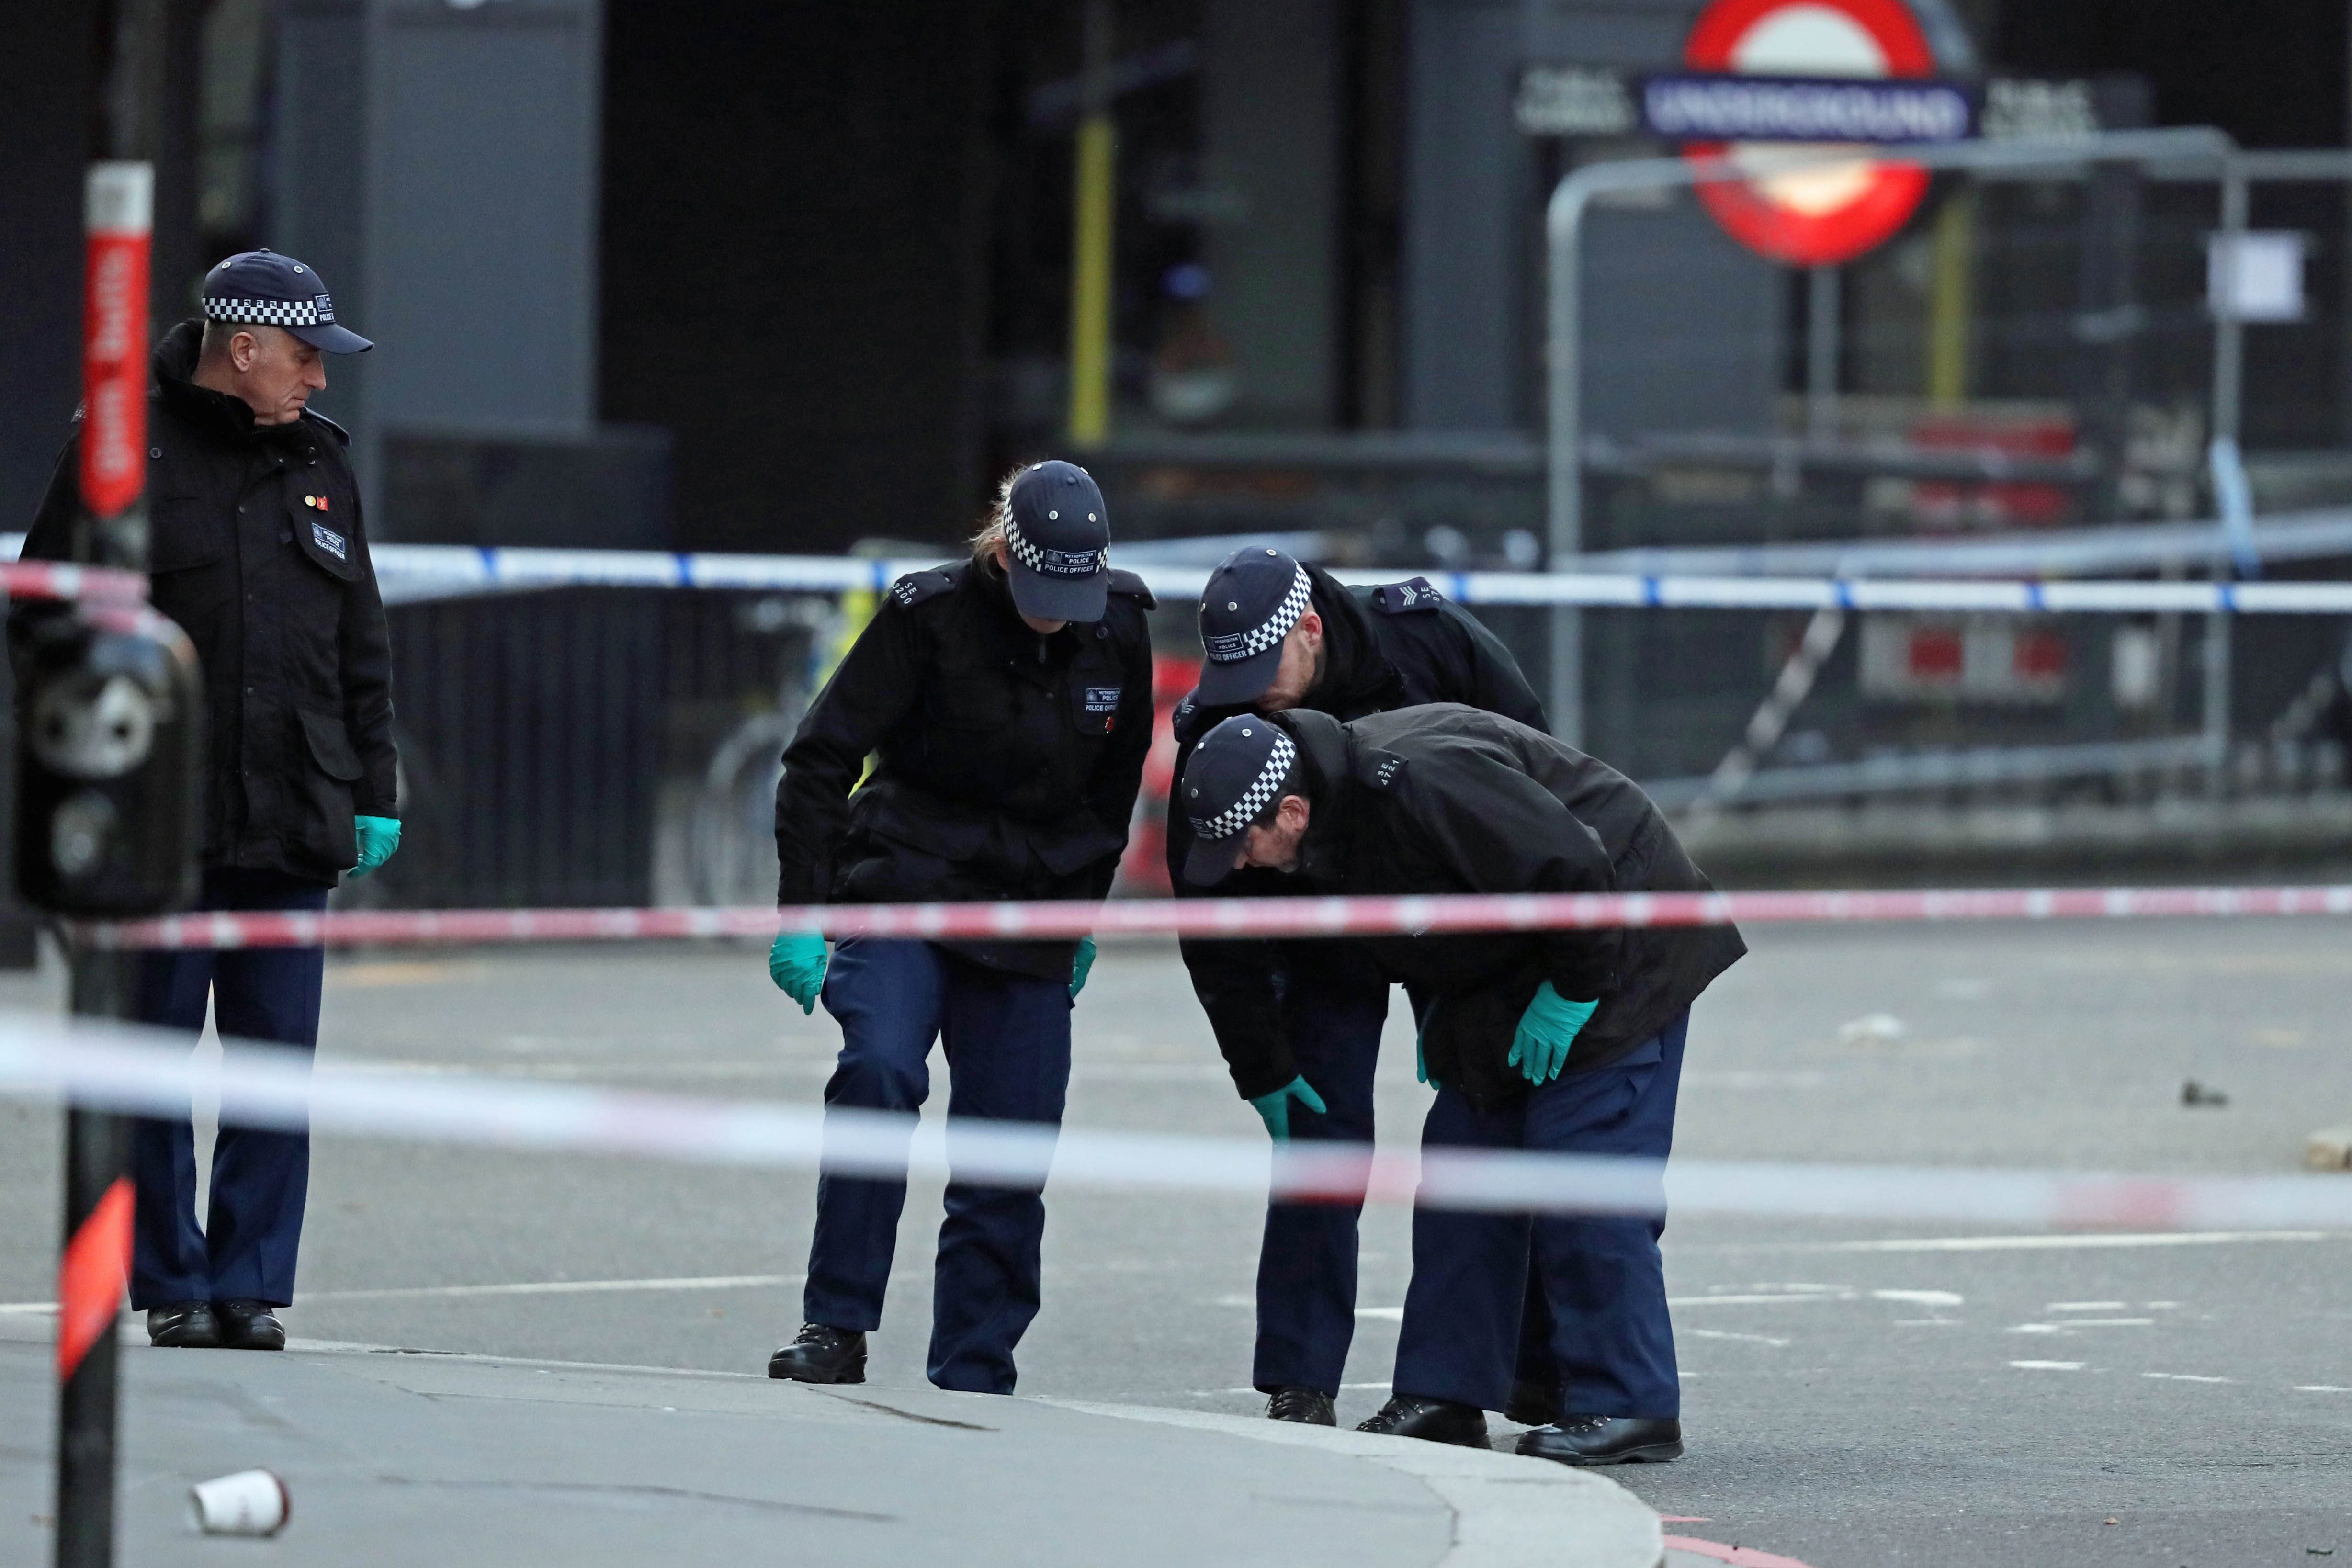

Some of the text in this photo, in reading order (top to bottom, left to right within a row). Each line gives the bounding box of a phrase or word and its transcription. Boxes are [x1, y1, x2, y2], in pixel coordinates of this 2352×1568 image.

[1646, 80, 1966, 137] UNDERGROUND
[327, 536, 339, 547] POLICE
[315, 538, 345, 560] POLICE OFFICER
[1045, 564, 1094, 573] POLICE OFFICER
[893, 583, 912, 604] 3200
[905, 582, 917, 594] SE
[1421, 587, 1431, 598] SE
[1223, 650, 1247, 661] OFFICER
[1377, 763, 1389, 776] SE
[1381, 759, 1400, 785] 4721
